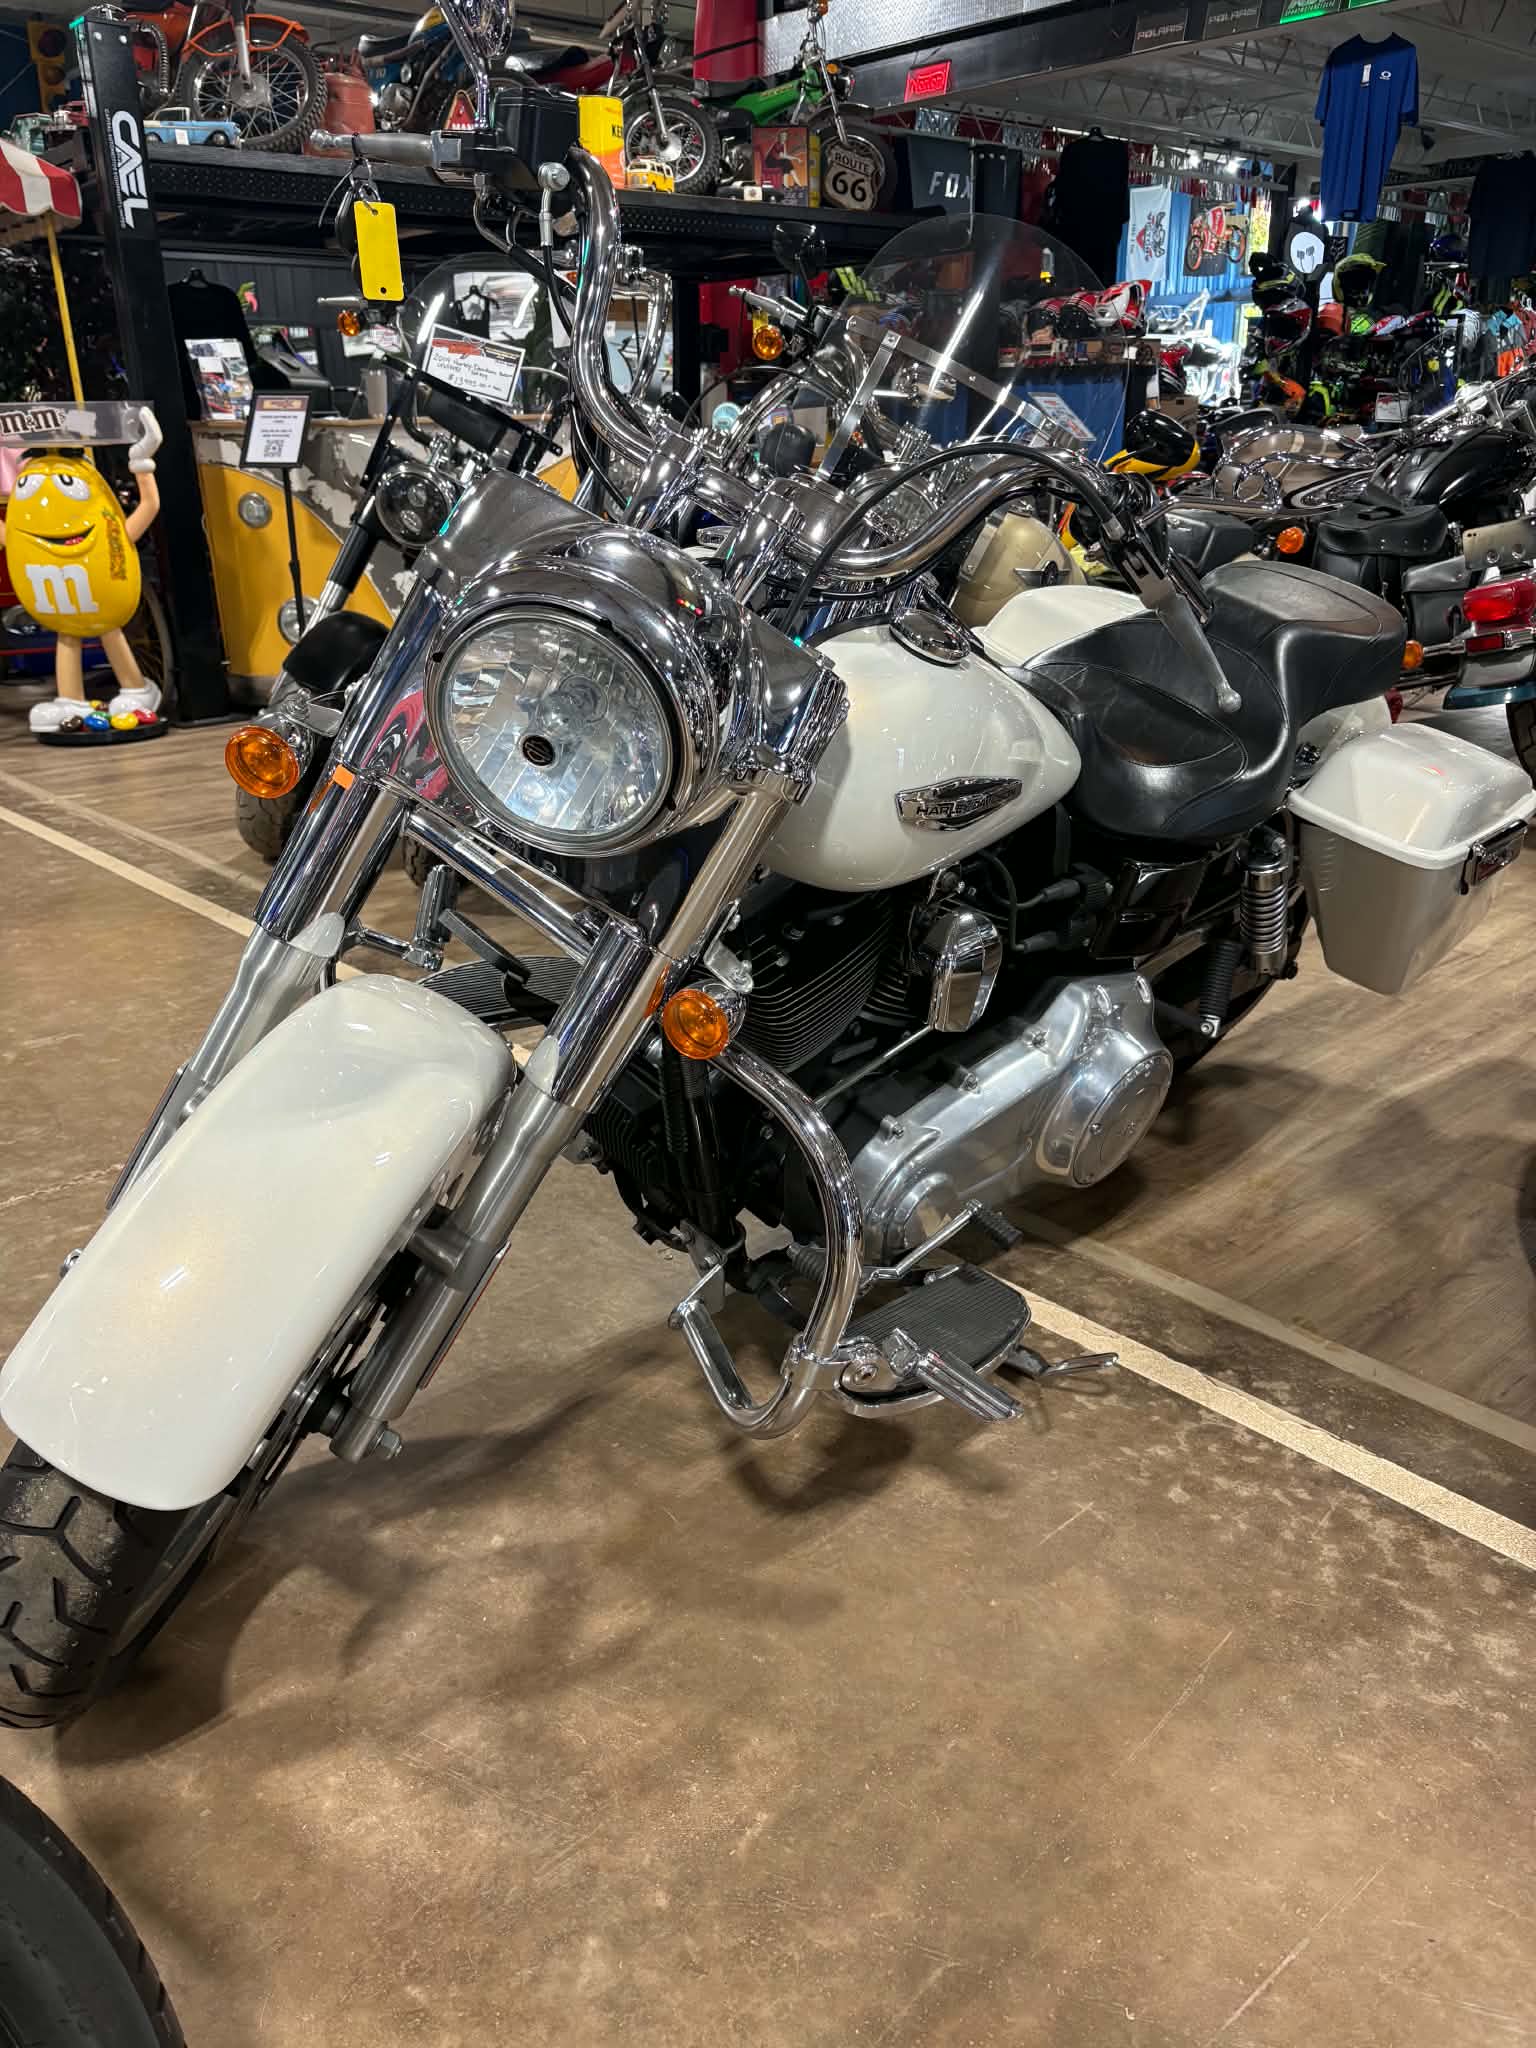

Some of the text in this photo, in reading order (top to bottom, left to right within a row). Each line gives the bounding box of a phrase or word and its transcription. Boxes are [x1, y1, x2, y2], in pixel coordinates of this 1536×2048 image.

[1136, 22, 1184, 40] POLARIS
[834, 151, 870, 174] ROUTE
[832, 171, 868, 202] 66
[25, 564, 98, 614] m
